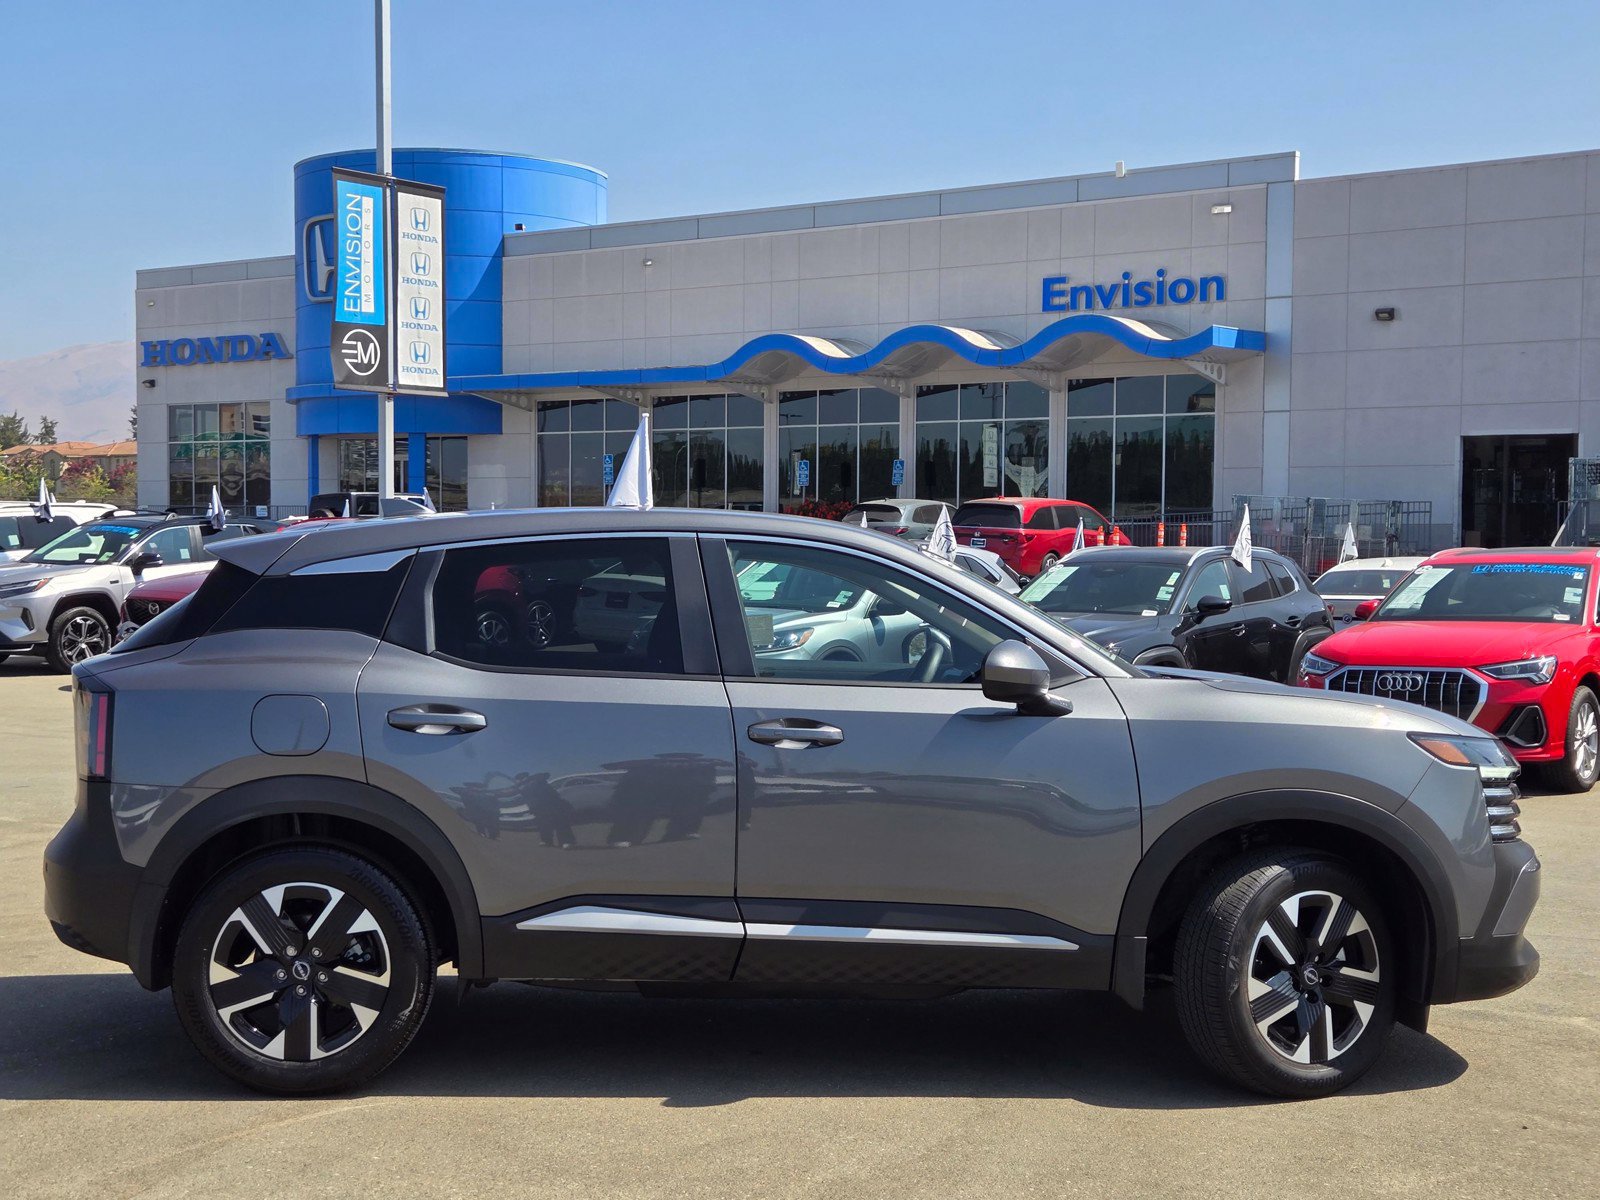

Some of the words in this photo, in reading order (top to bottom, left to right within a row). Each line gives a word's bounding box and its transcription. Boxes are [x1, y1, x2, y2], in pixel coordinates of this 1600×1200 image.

[401, 232, 438, 244] HONDA
[344, 193, 362, 313] ENVISION
[364, 207, 372, 303] MOTORS
[401, 277, 438, 288] HONDA
[1042, 269, 1225, 312] Envision
[401, 321, 438, 332] HONDA
[141, 333, 292, 367] HONDA
[401, 365, 439, 376] HONDA
